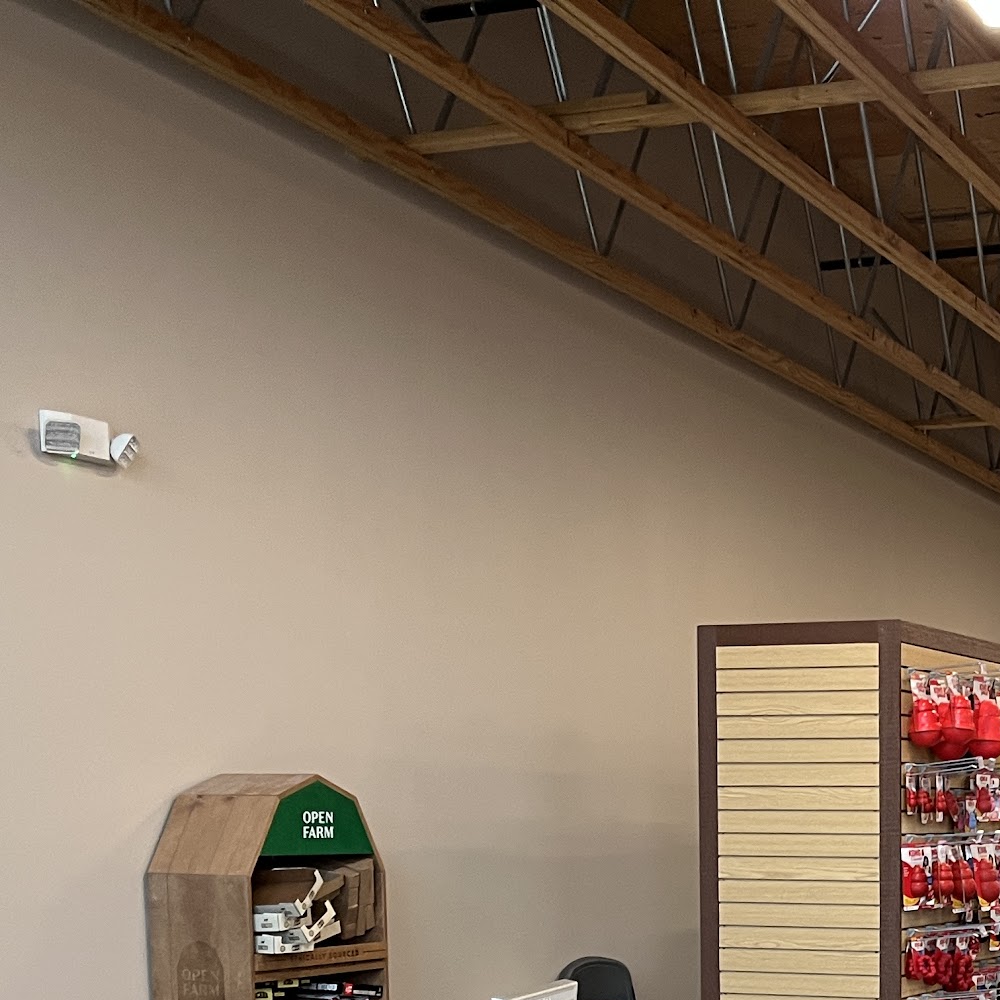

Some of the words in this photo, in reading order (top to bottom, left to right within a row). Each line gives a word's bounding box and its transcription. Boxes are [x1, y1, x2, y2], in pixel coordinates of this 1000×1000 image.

[302, 810, 334, 824] OPEN
[302, 826, 334, 839] FARM
[182, 968, 220, 981] OPEN
[182, 983, 220, 997] FARM
